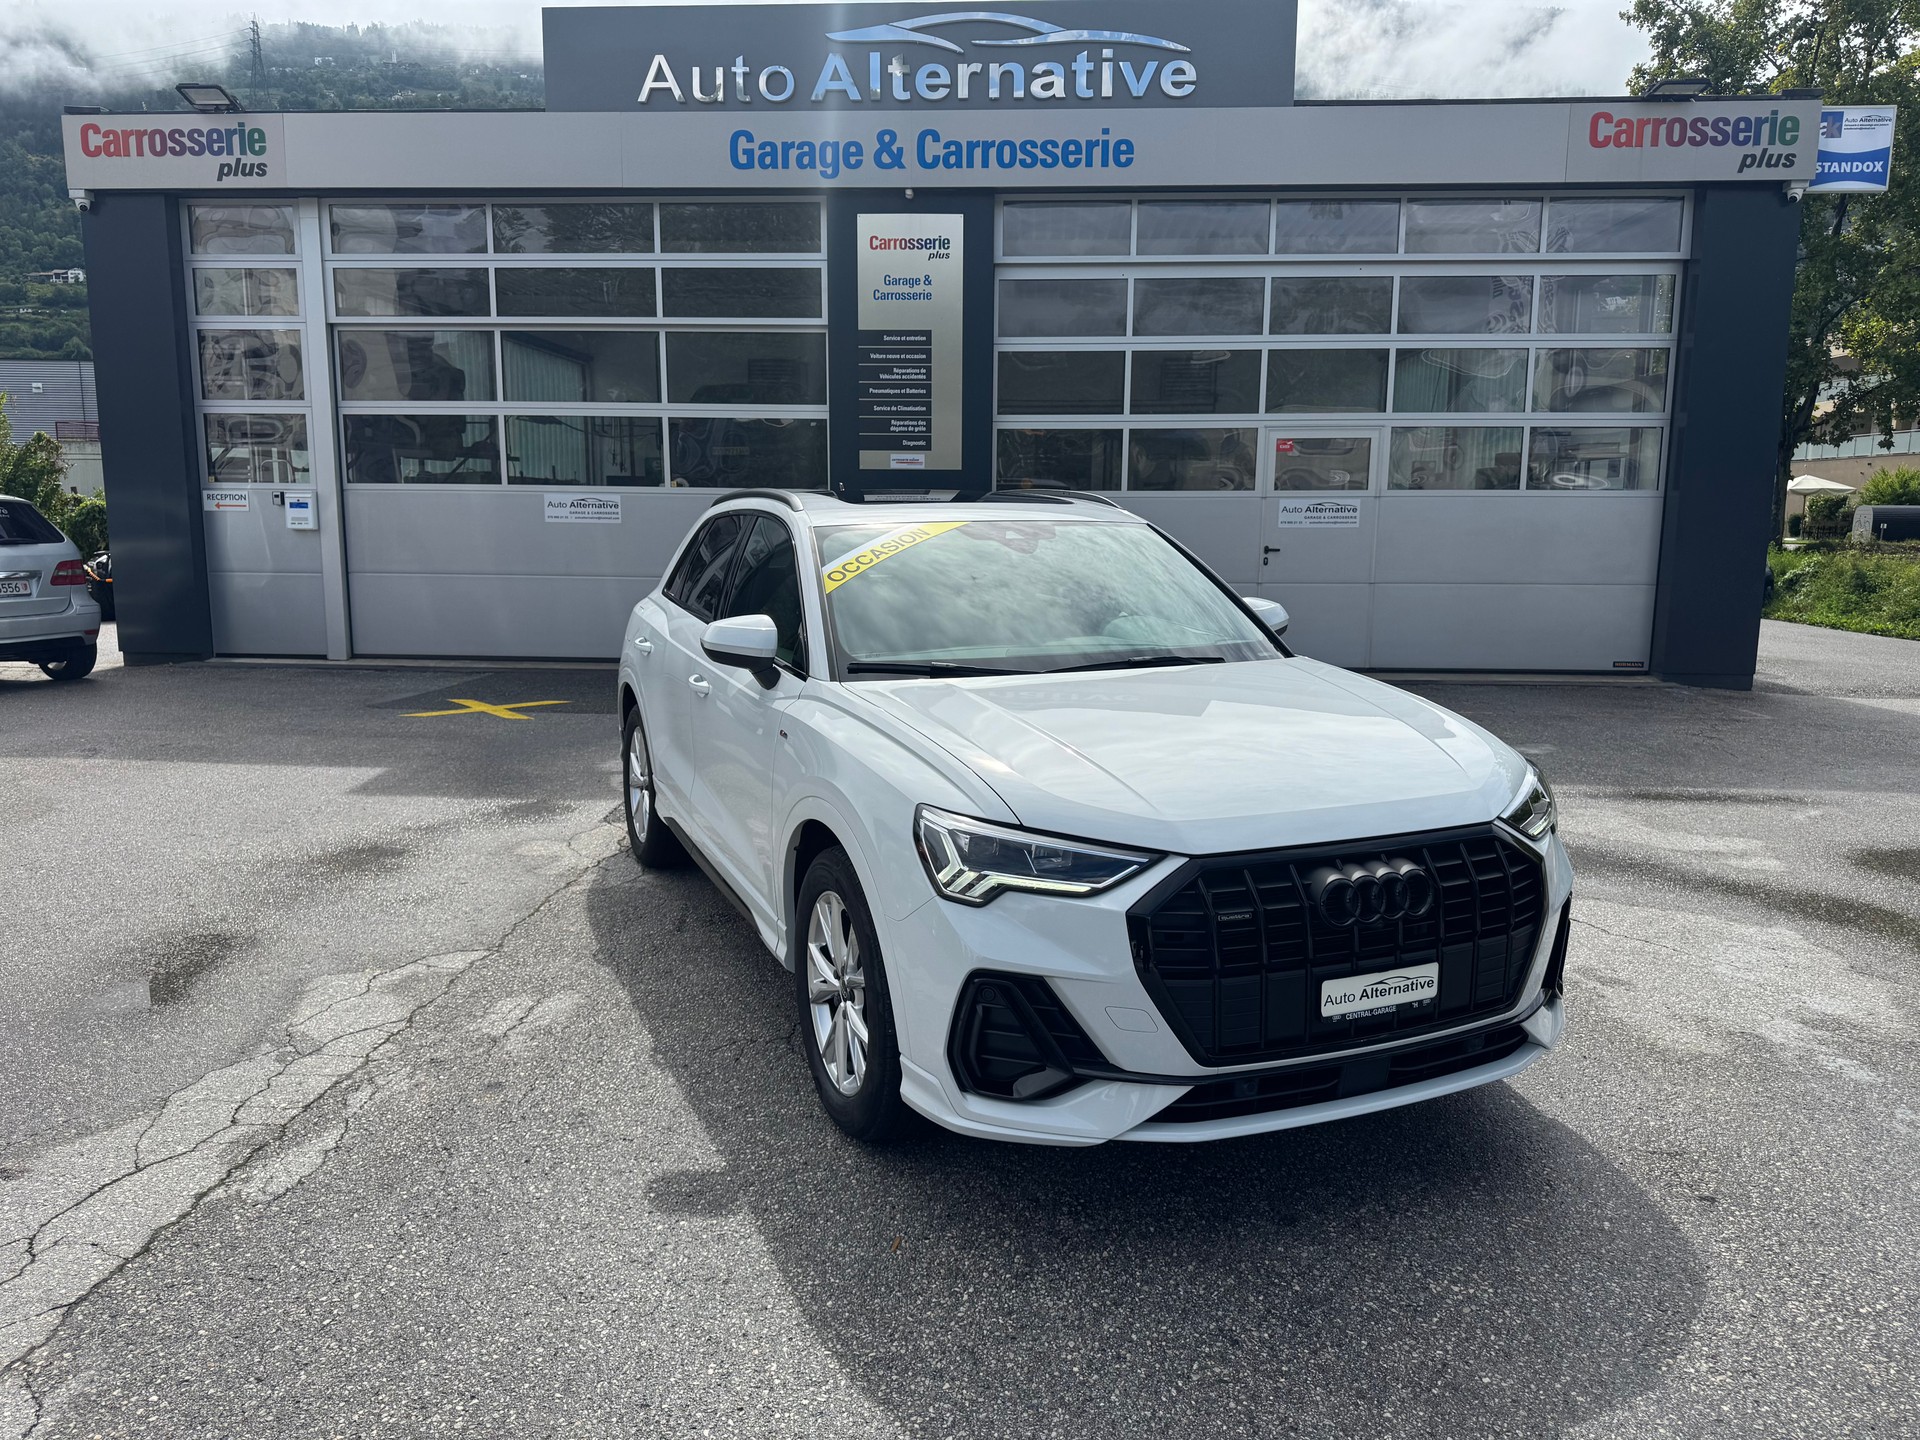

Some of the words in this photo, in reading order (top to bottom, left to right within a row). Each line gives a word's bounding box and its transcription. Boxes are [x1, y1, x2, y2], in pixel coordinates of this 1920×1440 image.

[637, 54, 796, 103] Auto
[811, 48, 1198, 103] Alternative
[1589, 110, 1800, 148] Carrosserie
[80, 122, 267, 158] Carrosserie
[729, 129, 864, 179] Garage
[873, 128, 905, 169] &
[916, 127, 1135, 169] Carrosserie
[1737, 148, 1798, 173] plus
[216, 157, 268, 182] plus
[1815, 161, 1885, 173] STANDOX
[869, 235, 951, 250] Carrosserie
[927, 251, 951, 261] plus
[883, 274, 921, 288] Garage
[923, 274, 932, 286] &
[873, 289, 932, 301] Carrosserie
[206, 493, 247, 501] RECEPTION
[547, 501, 568, 509] Auto
[569, 500, 620, 509] Alternative
[1281, 506, 1303, 514] Auto
[1304, 505, 1358, 514] Alternative
[827, 528, 930, 582] OCCASION
[0, 582, 20, 593] 556
[1324, 993, 1356, 1007] Auto
[1359, 979, 1435, 1001] Alternative
[1346, 1005, 1397, 1020] CENTRAL-GARAGE
